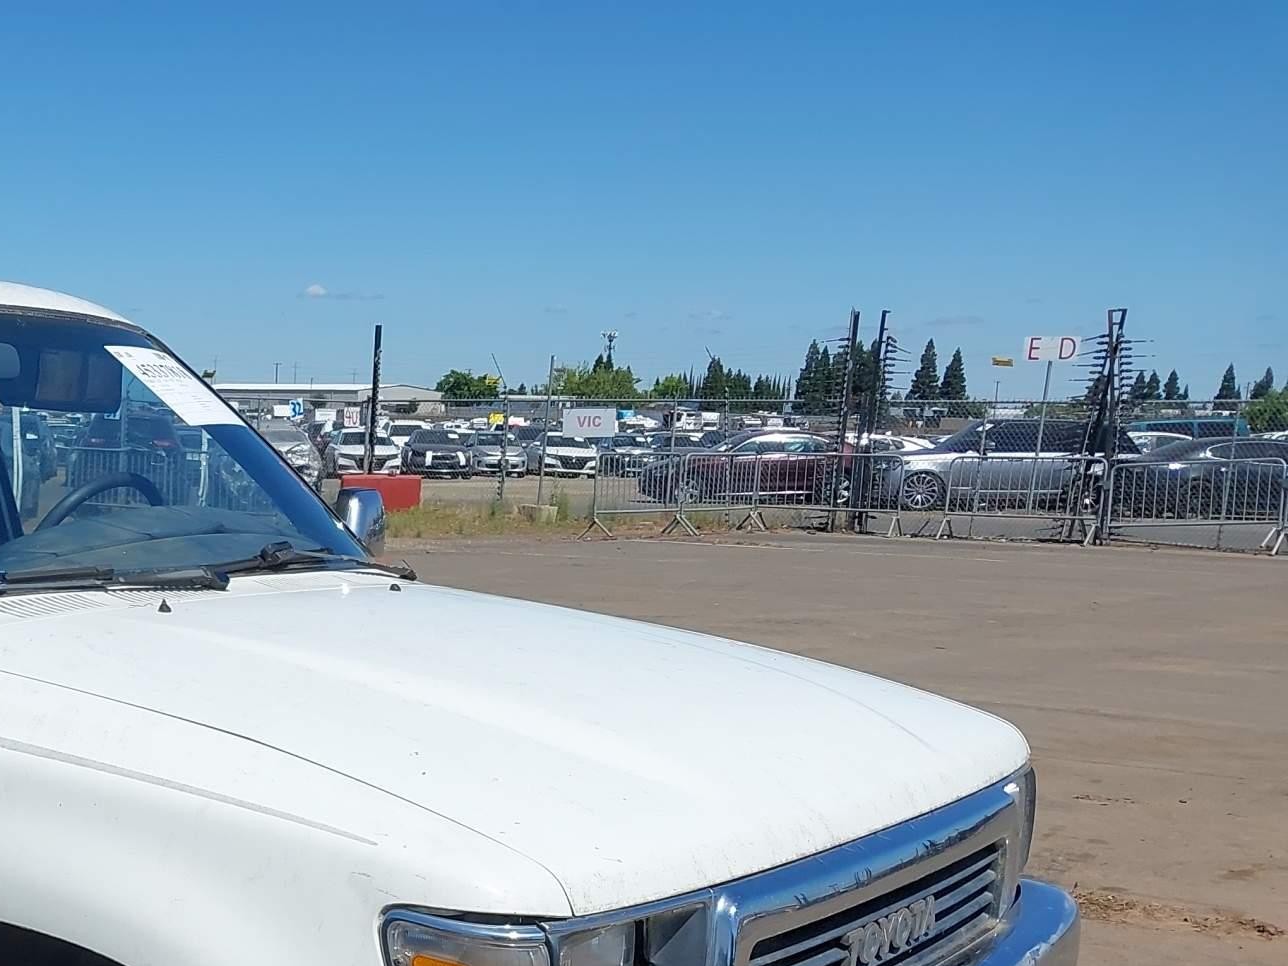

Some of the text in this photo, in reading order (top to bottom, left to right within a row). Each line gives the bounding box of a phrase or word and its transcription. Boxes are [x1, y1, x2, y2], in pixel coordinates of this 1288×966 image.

[1027, 336, 1077, 361] E D
[290, 401, 305, 418] 32
[577, 415, 602, 428] VIC
